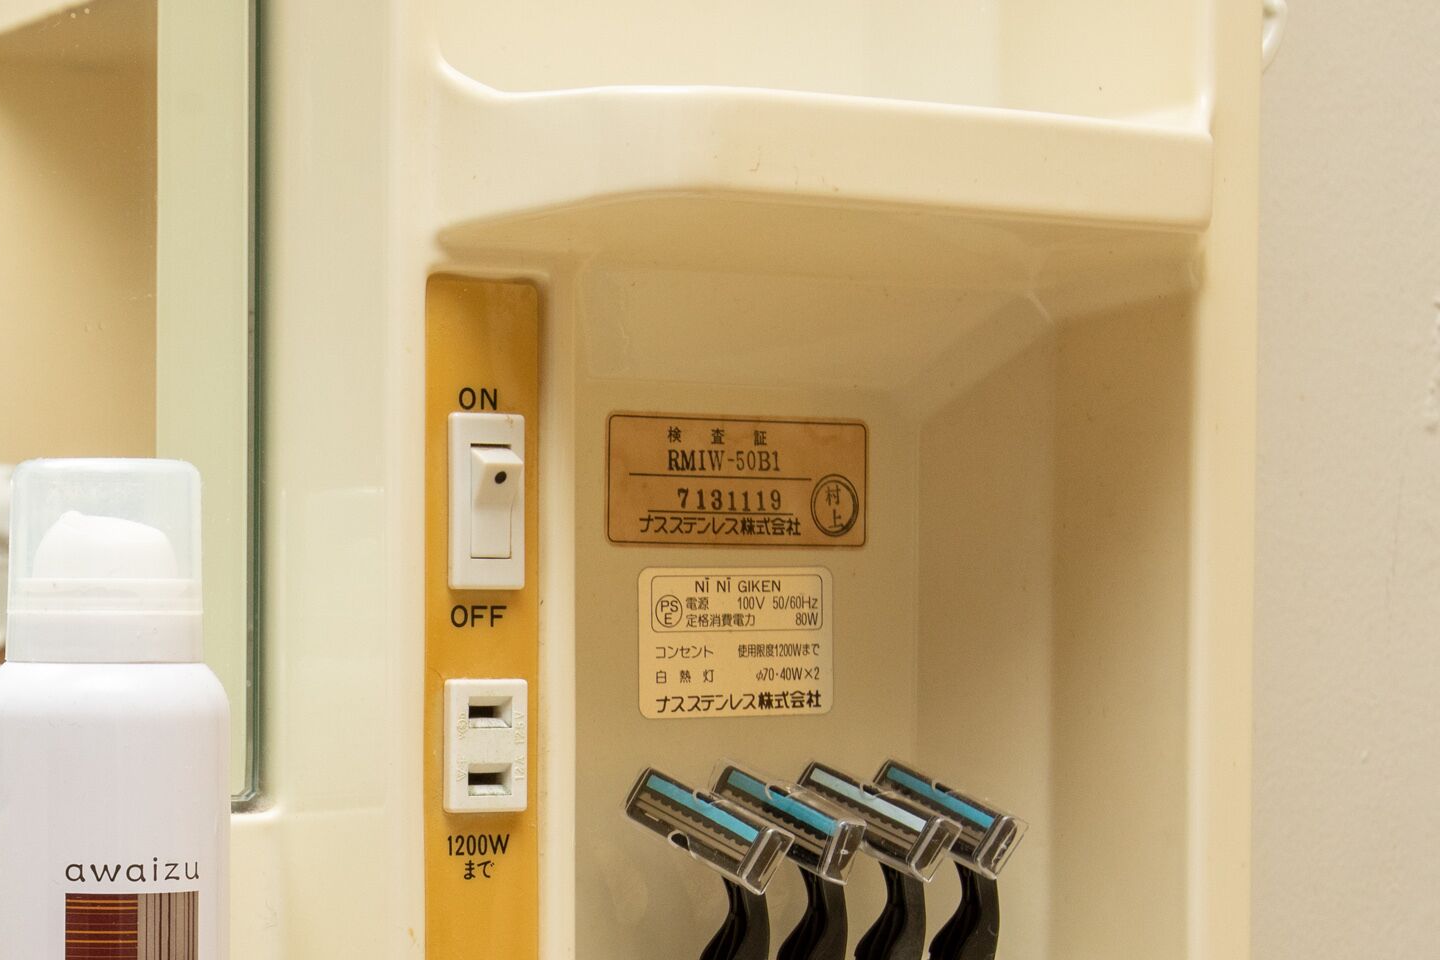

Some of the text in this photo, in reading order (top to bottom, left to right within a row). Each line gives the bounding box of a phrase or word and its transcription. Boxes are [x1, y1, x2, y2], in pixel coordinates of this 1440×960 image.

[458, 387, 498, 411] ON
[668, 449, 781, 472] RMIW-50B1
[677, 488, 782, 512] 7131119
[639, 514, 801, 536] ナスステンレス株式会社
[737, 580, 781, 593] GIKEN
[685, 596, 818, 611] 電源 100V 50/60Hz
[450, 605, 507, 628] OFF
[686, 612, 818, 628] 定格消費電力 80W
[656, 643, 820, 659] コンセント 使用限度1200Wまで
[656, 690, 821, 713] ナスステンレス株式会社
[447, 833, 510, 856] 1200W
[65, 857, 200, 884] awaizu
[463, 860, 495, 880] まで
